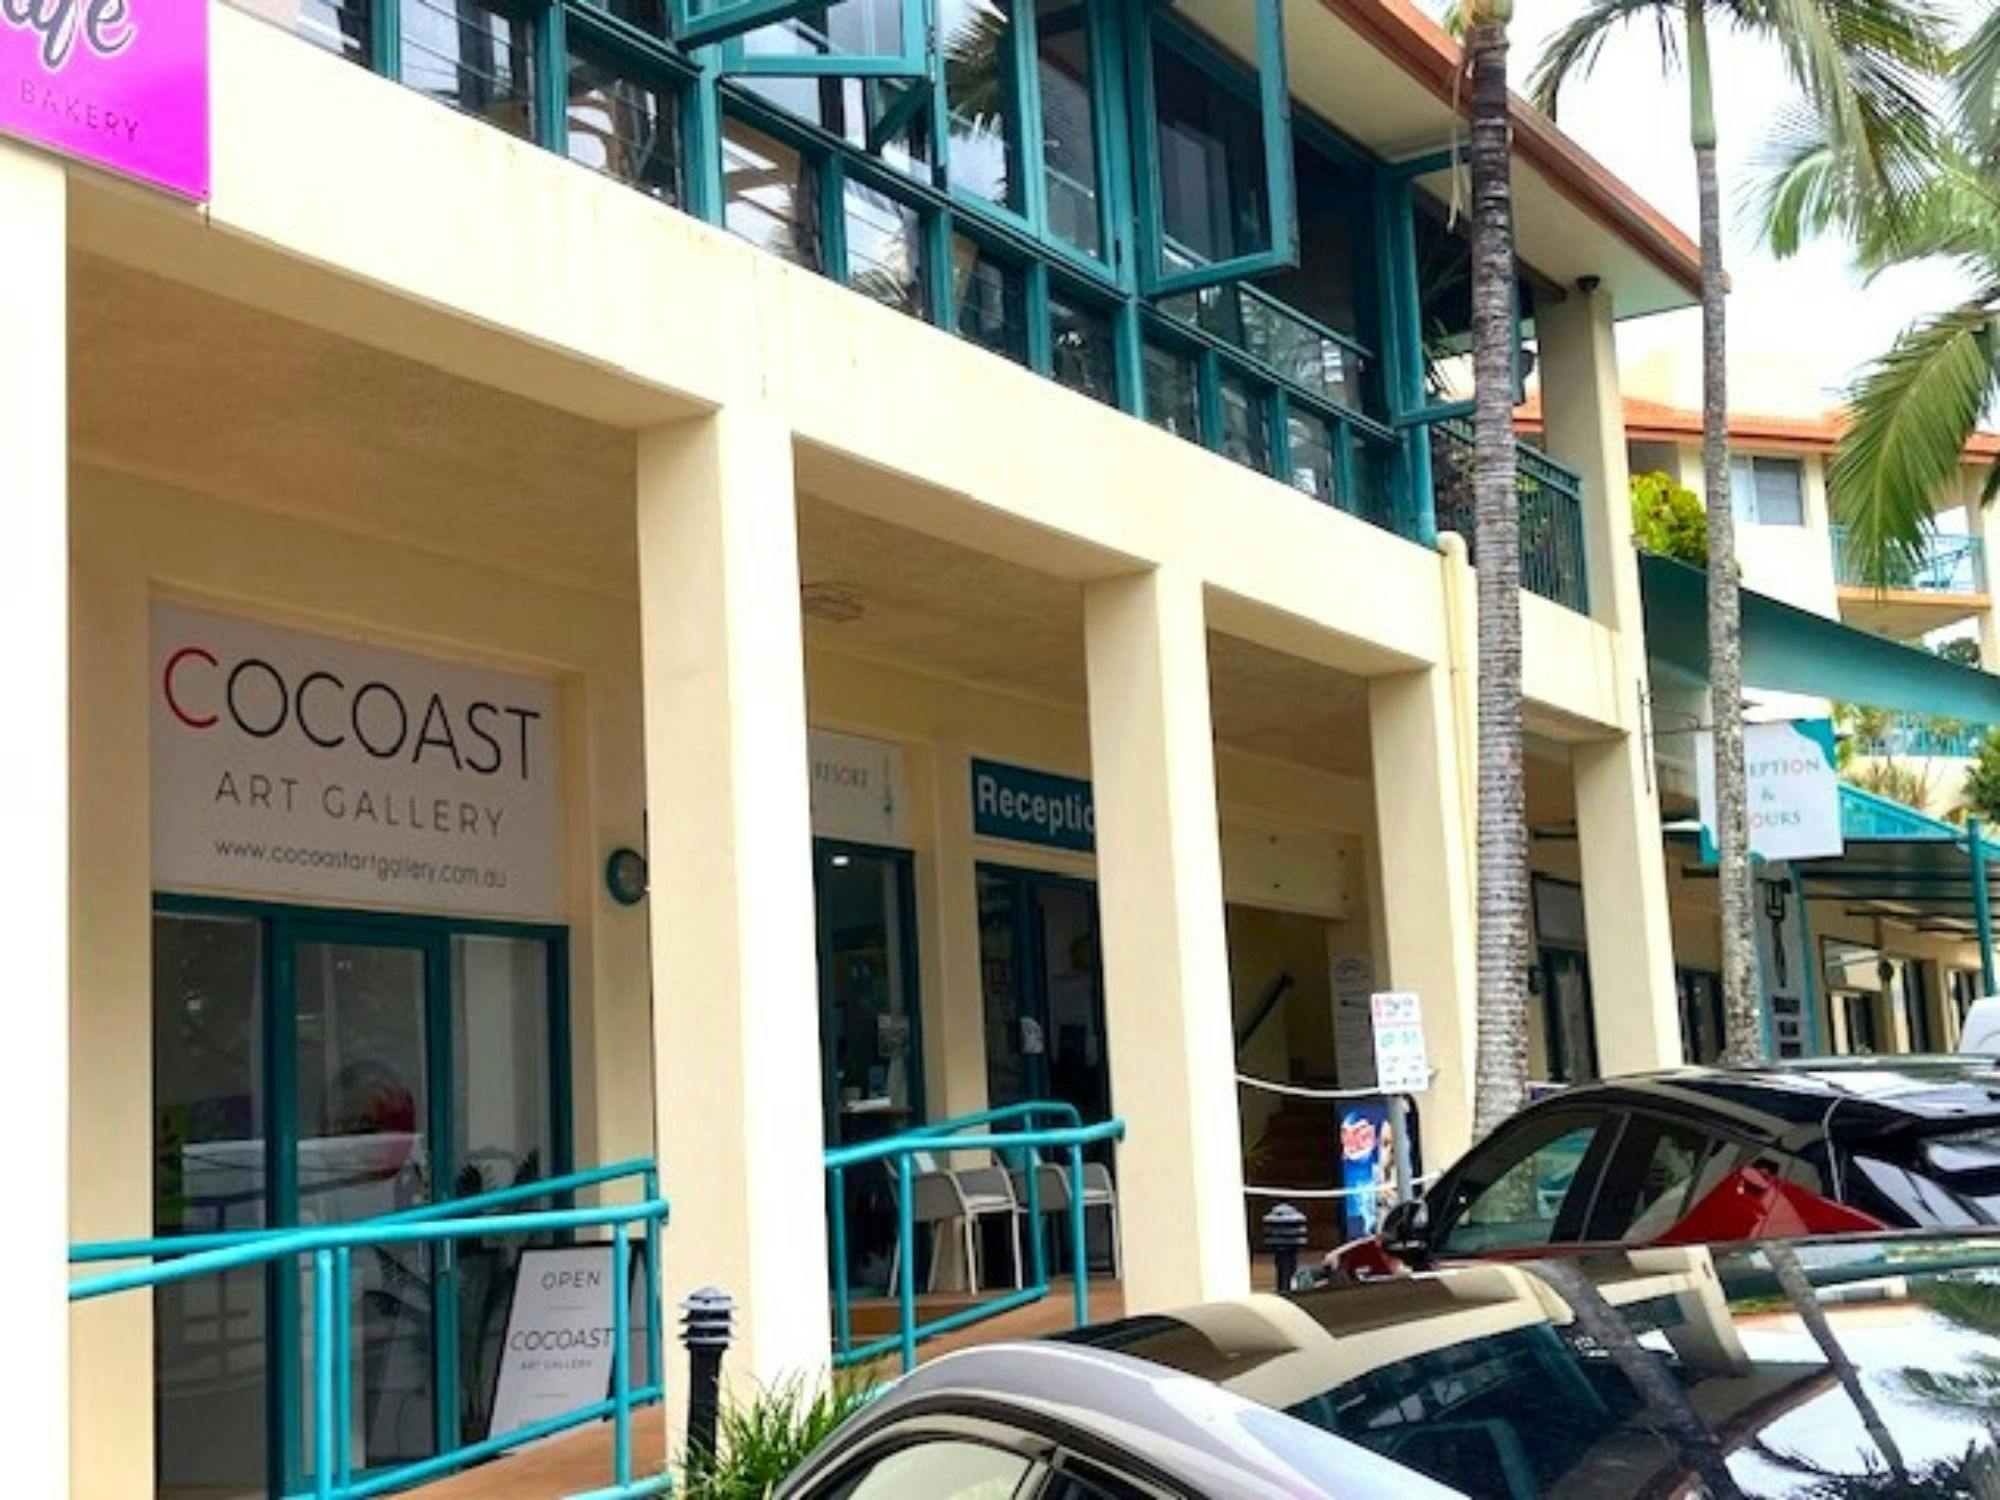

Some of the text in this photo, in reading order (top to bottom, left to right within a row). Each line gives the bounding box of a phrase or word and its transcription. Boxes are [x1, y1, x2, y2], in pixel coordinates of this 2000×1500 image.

[21, 78, 138, 141] BAKERY
[164, 646, 542, 780] COCOAST
[1750, 758, 1820, 777] EPTION
[215, 770, 505, 838] ART GALLERY
[976, 774, 1095, 836] Receptio
[1750, 811, 1801, 829] OURS
[213, 839, 508, 889] www.cocoastartgallery.com.au
[540, 1270, 601, 1291] OPEN
[511, 1327, 616, 1351] COCOAST
